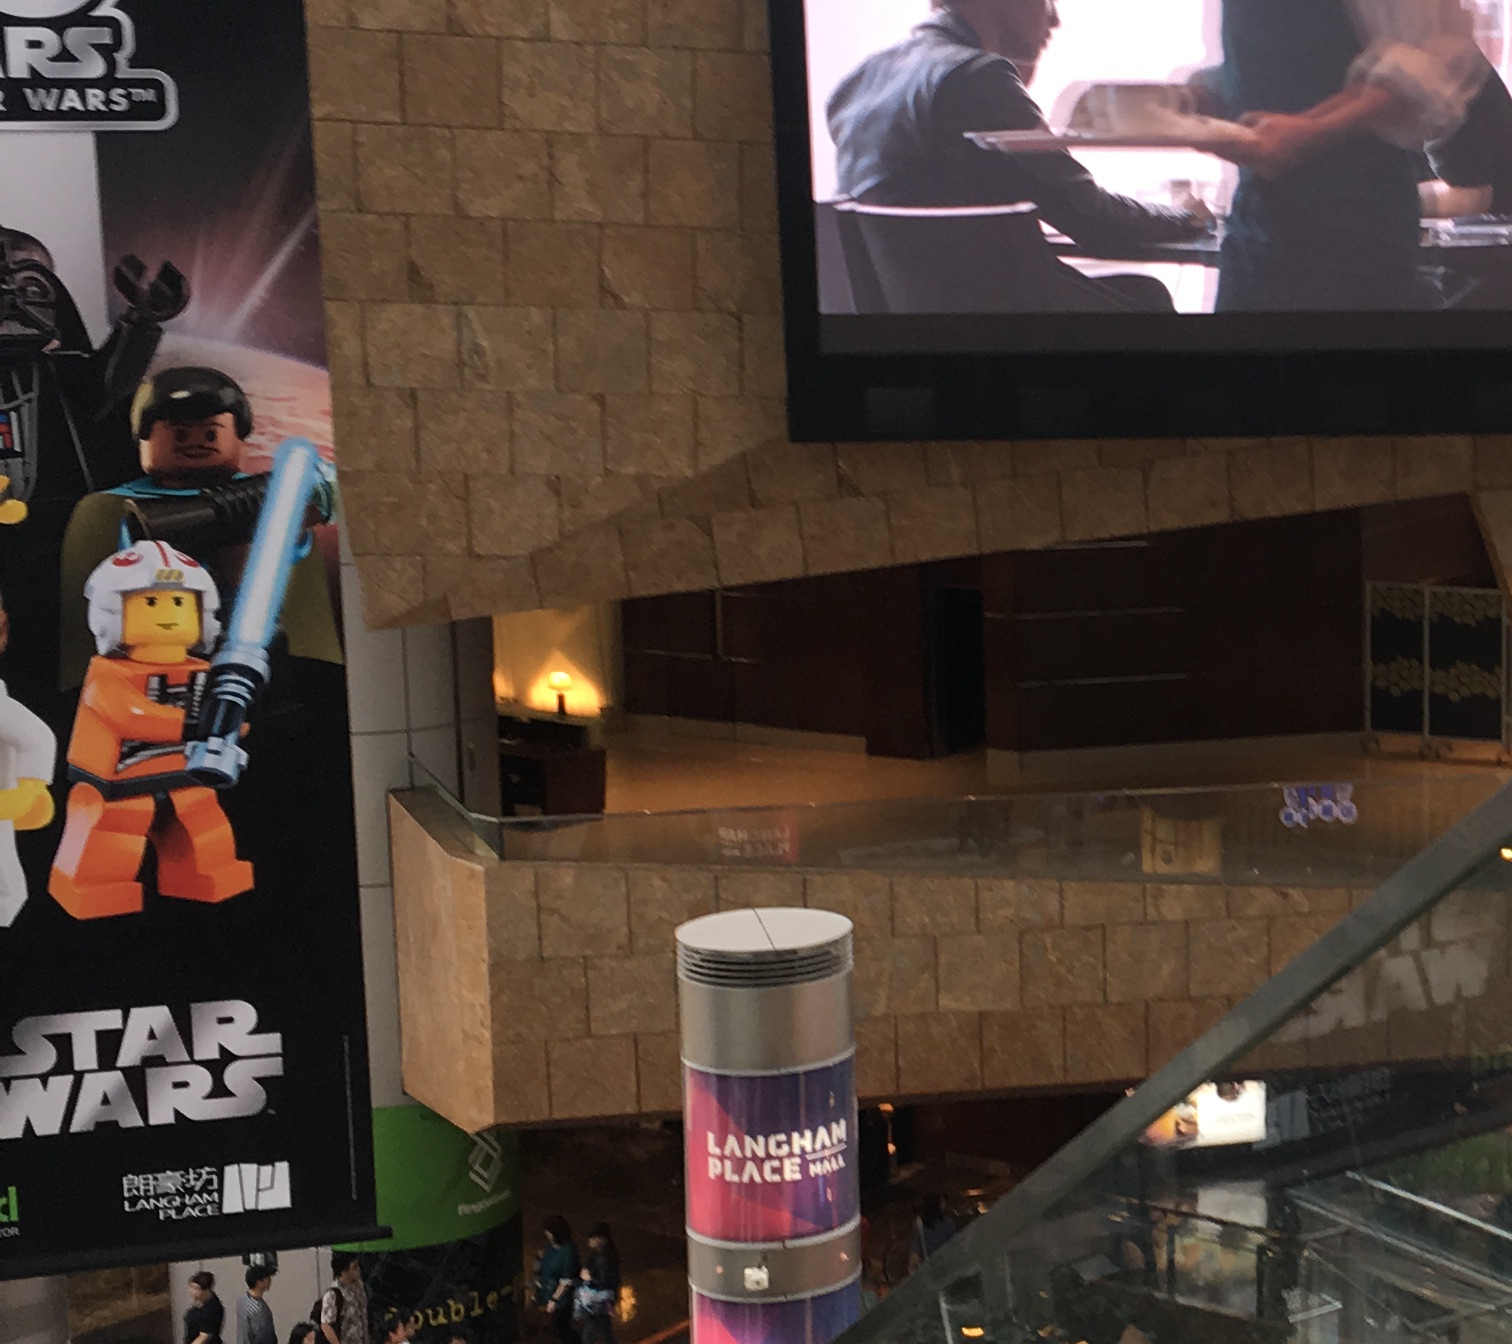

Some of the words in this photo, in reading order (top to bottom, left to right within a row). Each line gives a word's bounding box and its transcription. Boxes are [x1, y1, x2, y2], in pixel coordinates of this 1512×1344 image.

[0, 999, 283, 1077] STAR
[0, 1056, 284, 1140] WARS
[706, 1117, 847, 1158] LANGHAM
[122, 1165, 219, 1198] 朗豪坊
[708, 1155, 802, 1184] PLACE
[123, 1191, 219, 1213] LANGHAM
[158, 1204, 219, 1221] PLACE
